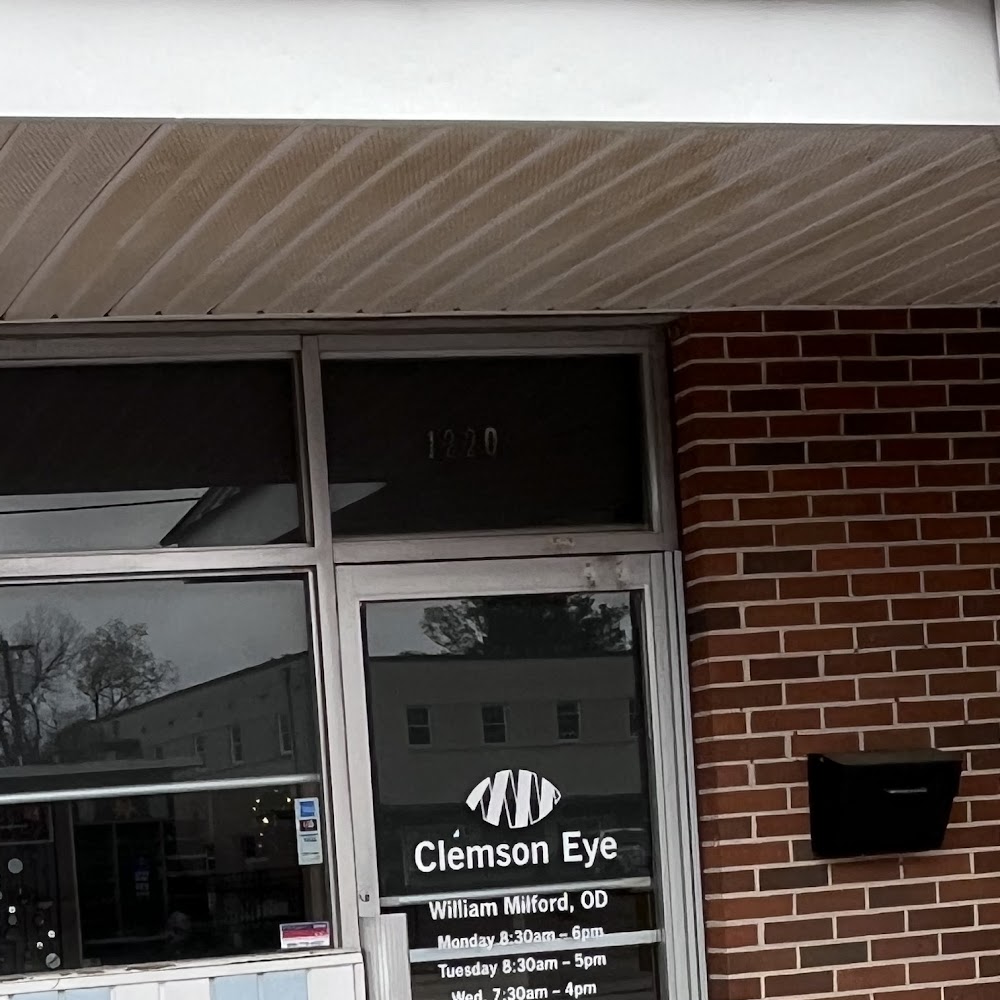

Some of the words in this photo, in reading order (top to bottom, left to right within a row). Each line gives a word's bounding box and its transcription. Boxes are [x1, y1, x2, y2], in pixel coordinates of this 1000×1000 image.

[414, 839, 549, 873] Clemson
[562, 830, 618, 868] Eye
[429, 898, 498, 921] William
[503, 892, 574, 916] Milford,
[580, 889, 609, 910] OD
[437, 933, 496, 951] Monday
[499, 929, 556, 945] 8:30am
[572, 925, 605, 941] 6pm
[437, 961, 498, 979] Tuesday
[502, 956, 558, 975] 8:30am
[574, 953, 607, 970] 5pm
[565, 981, 597, 998] 4pm
